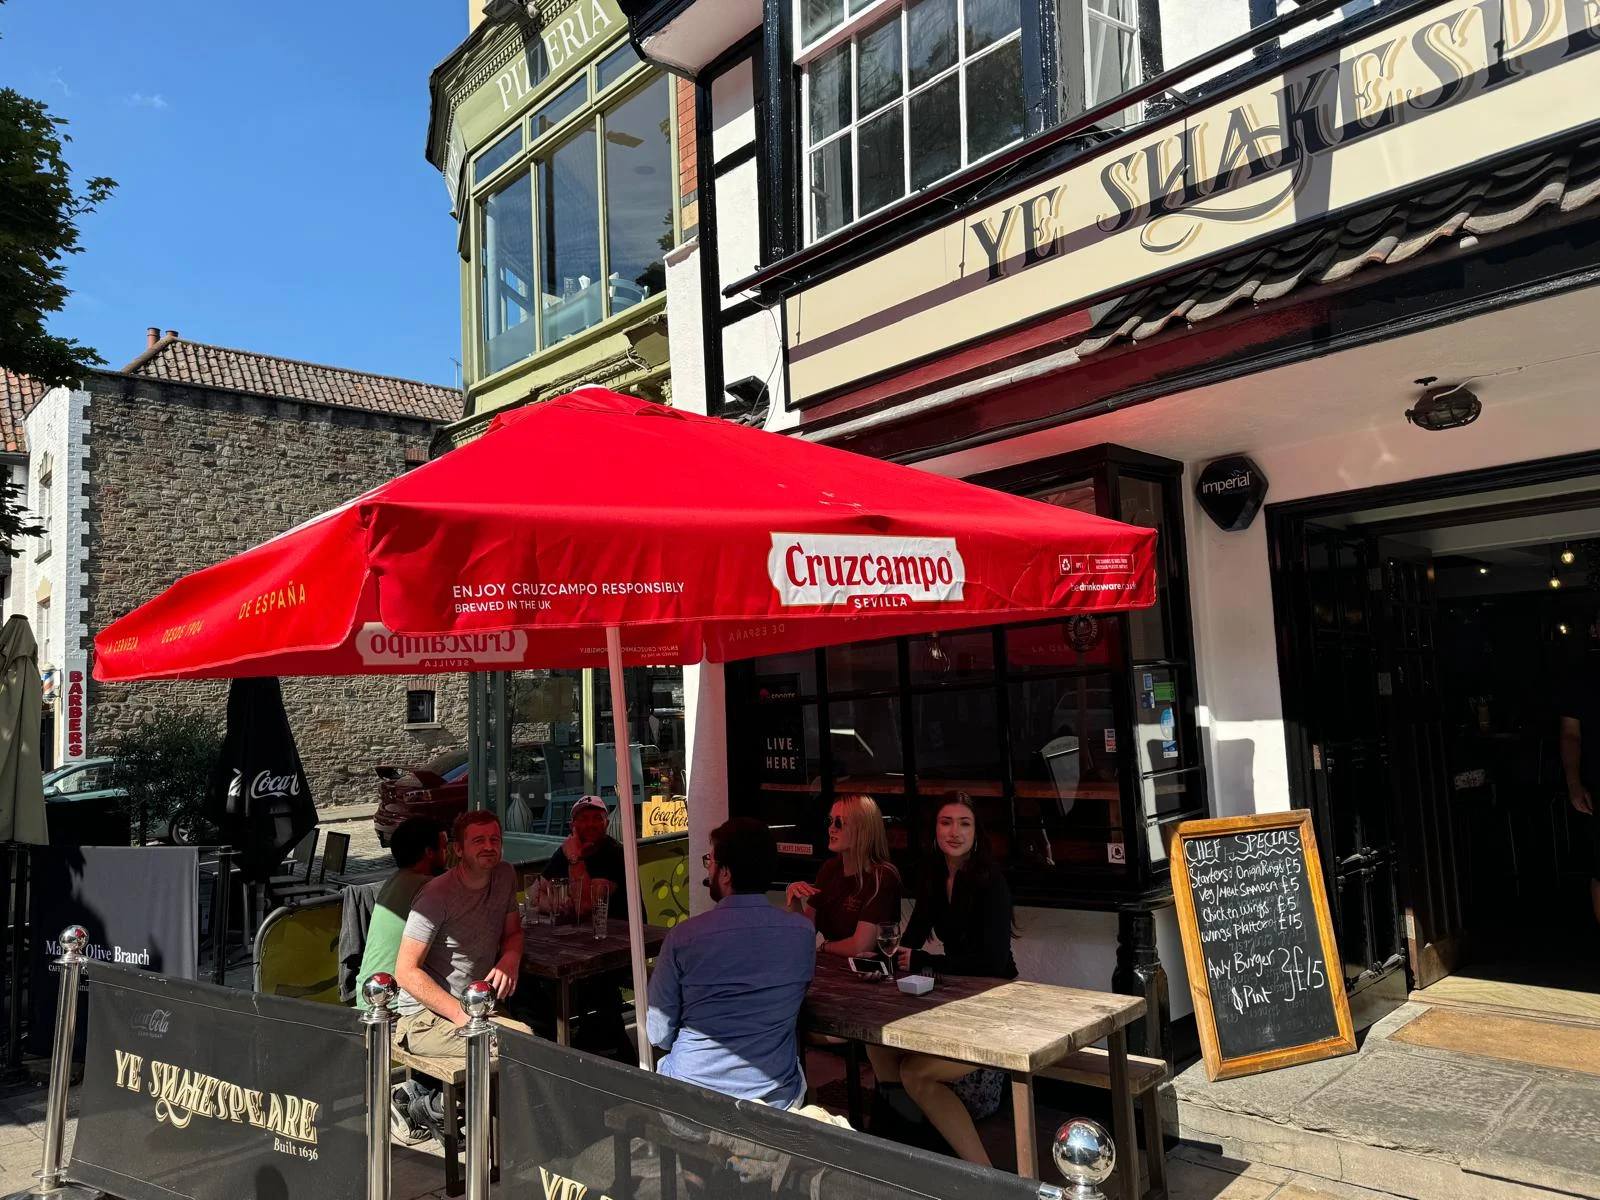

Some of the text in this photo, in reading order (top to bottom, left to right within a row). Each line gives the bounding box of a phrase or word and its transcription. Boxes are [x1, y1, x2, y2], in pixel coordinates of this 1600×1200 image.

[971, 184, 1066, 282] YE
[1202, 472, 1250, 494] imperial
[785, 542, 952, 591] Cruzcampo
[237, 581, 306, 621] DE ESPAÑA
[453, 582, 684, 598] ENJOY CRUZCAMPO RESPONSIBLY
[455, 600, 551, 613] BREWED IN THE UK
[854, 597, 907, 609] SEVILLA
[68, 671, 83, 757] BARBERS
[766, 737, 793, 750] LIVE
[766, 756, 796, 769] HERE
[1184, 831, 1300, 861] CHEF SPECIALS
[1285, 856, 1301, 875] £5
[1281, 875, 1300, 894] £5
[1277, 895, 1297, 913] £5
[1279, 912, 1303, 930] £15
[86, 943, 112, 961] Olive
[114, 945, 150, 966] Branch
[1234, 949, 1274, 977] Burger
[1243, 985, 1272, 1008] Pint
[115, 1049, 320, 1144] YE SHAKESPEARE
[273, 1137, 319, 1163] Built 1636
